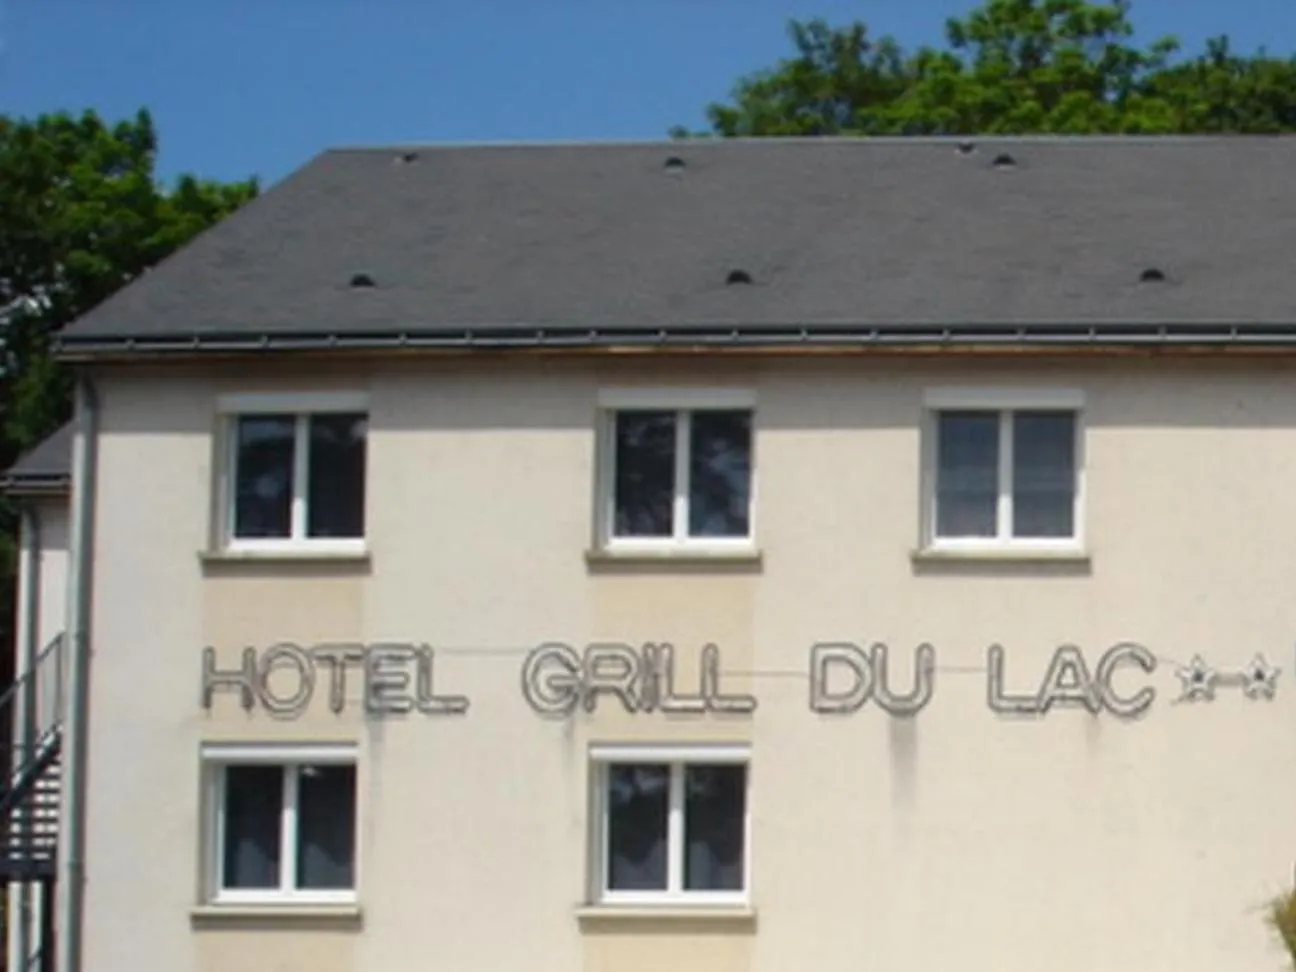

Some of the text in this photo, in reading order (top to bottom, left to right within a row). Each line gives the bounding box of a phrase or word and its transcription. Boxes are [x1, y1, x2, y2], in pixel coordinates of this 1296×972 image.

[203, 642, 1156, 718] HOTEL GRILL DU LAC
